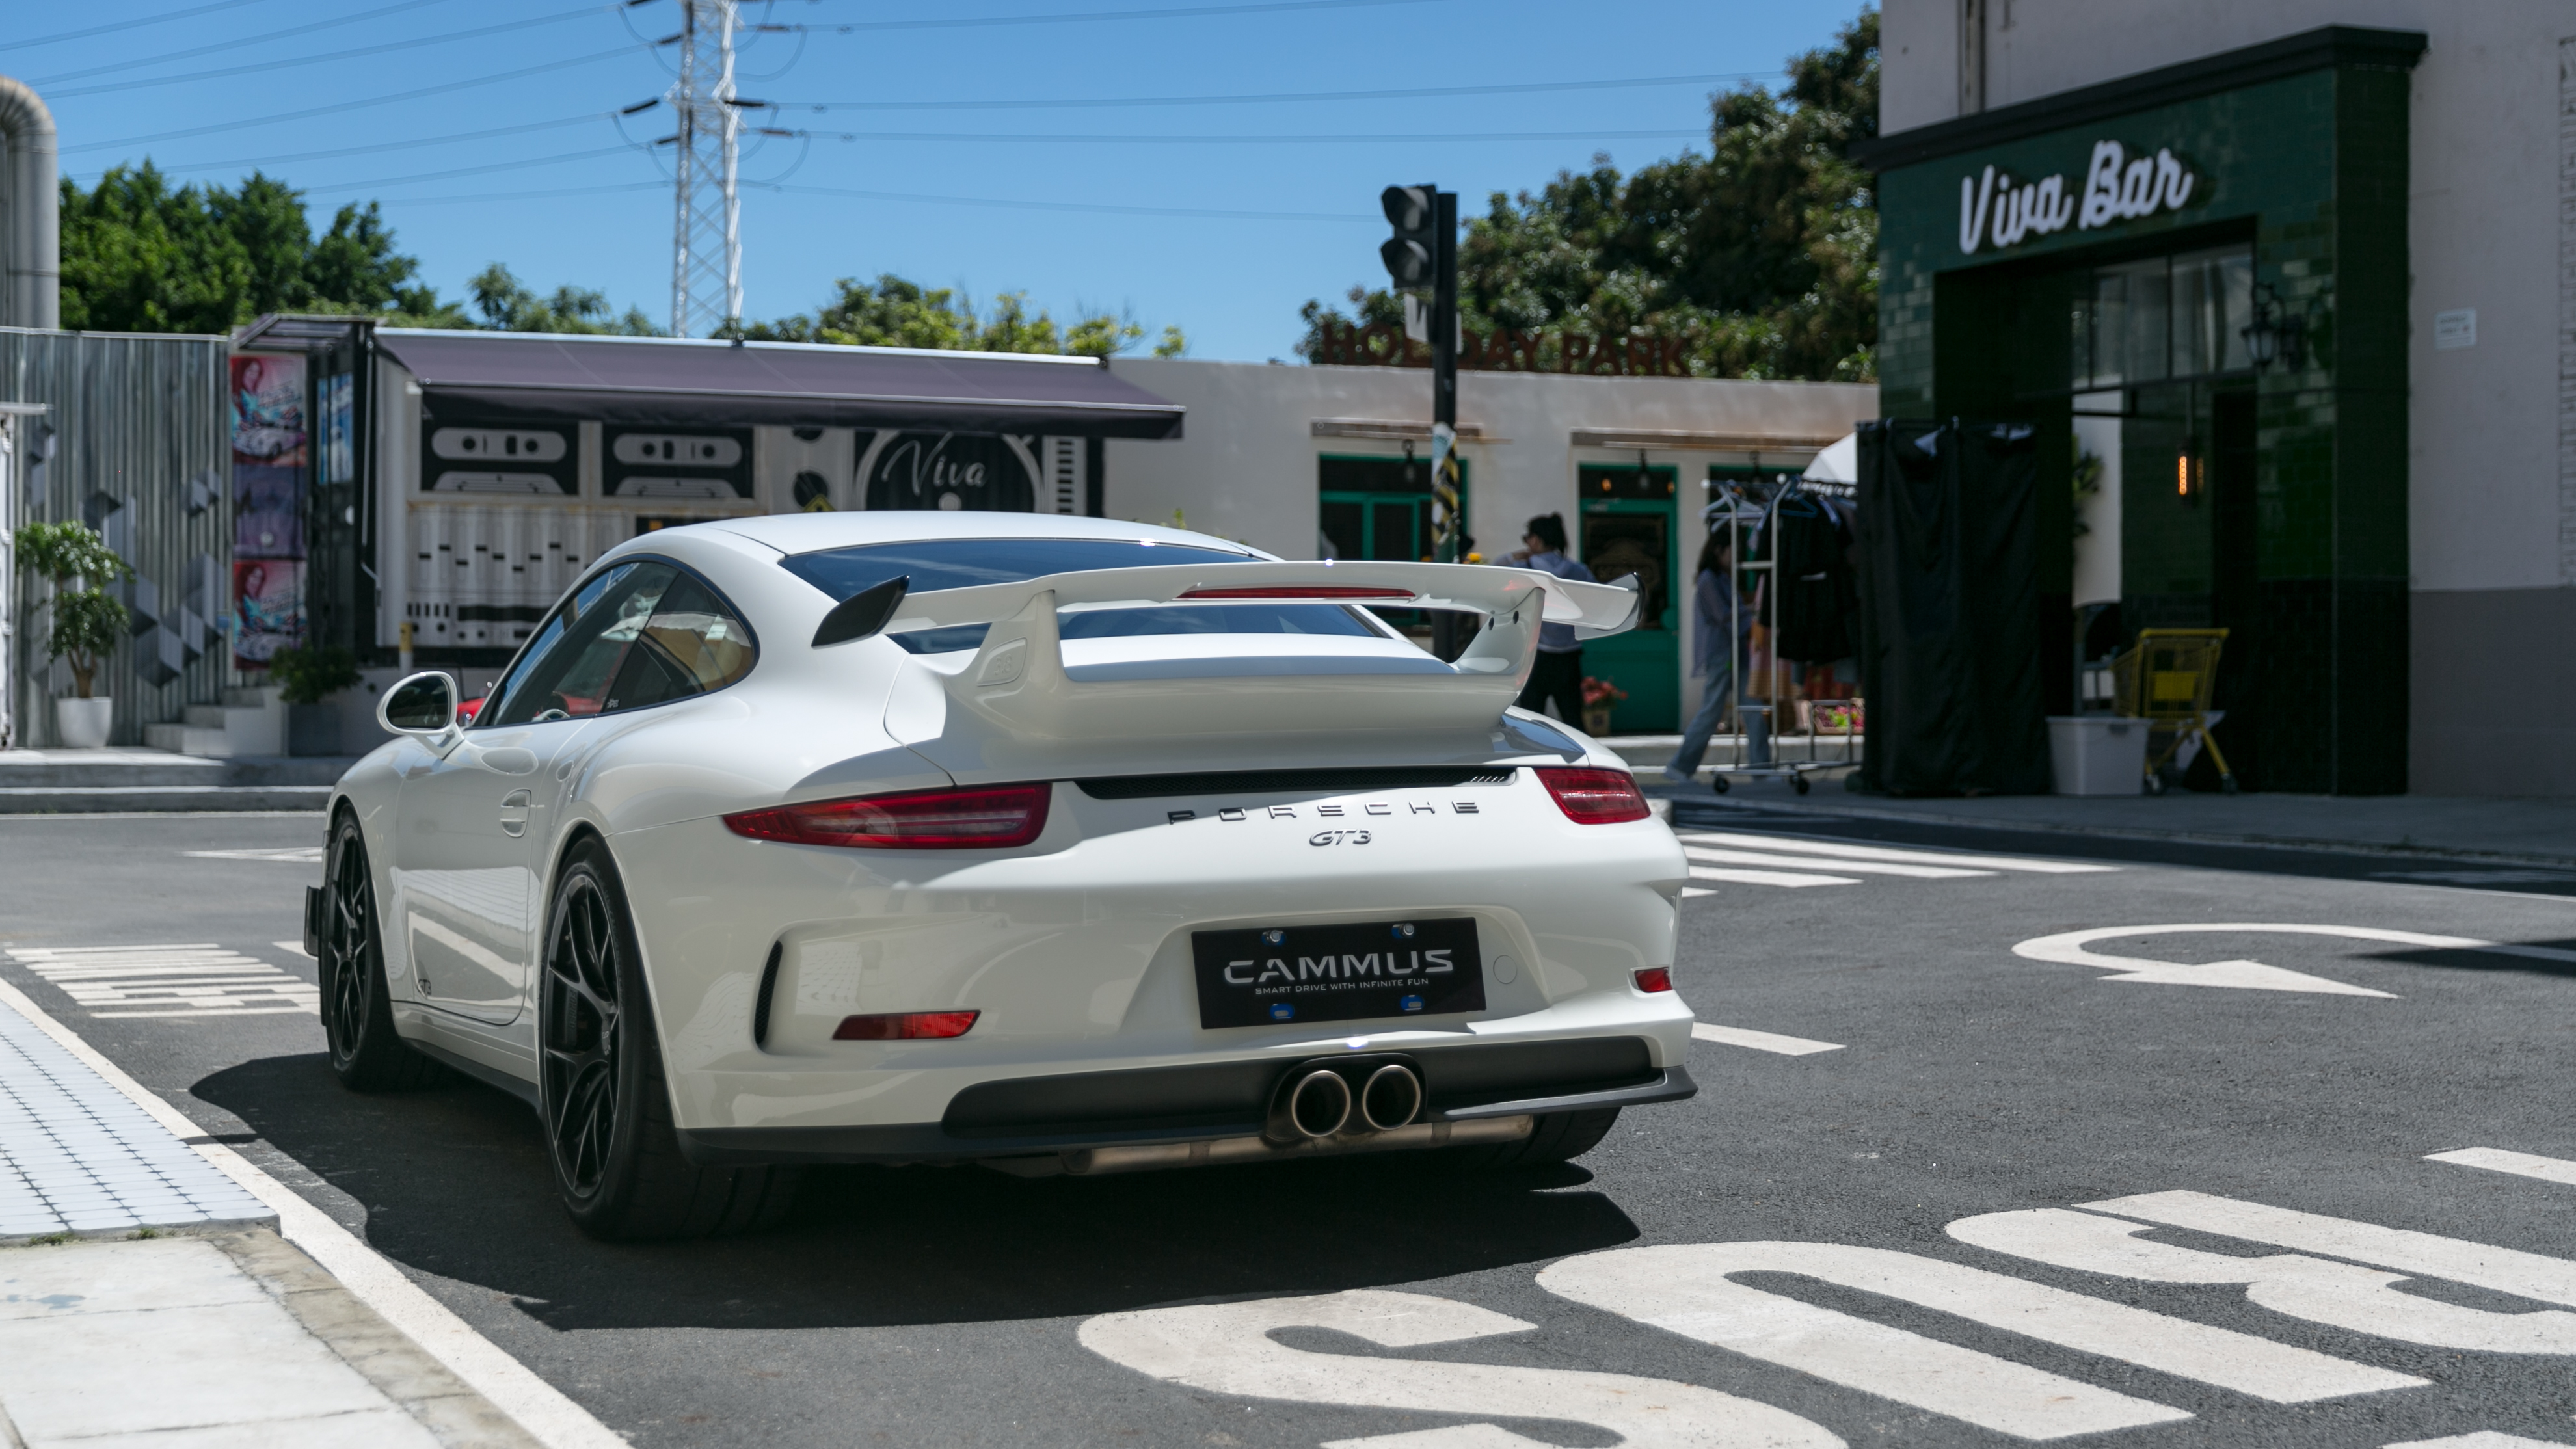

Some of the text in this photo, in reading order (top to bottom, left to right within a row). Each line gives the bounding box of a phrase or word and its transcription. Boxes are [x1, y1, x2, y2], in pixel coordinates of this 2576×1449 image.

[1959, 139, 2194, 255] Viva Bar
[1322, 323, 1691, 377] HOLDAY PARK
[881, 431, 987, 496] Viva
[1167, 800, 1480, 825] PORSCHE
[1309, 829, 1372, 847] GT3
[1224, 949, 1453, 984] CAMMUS
[1255, 977, 1429, 995] SMART DRIVE WITH INFINITE FUN
